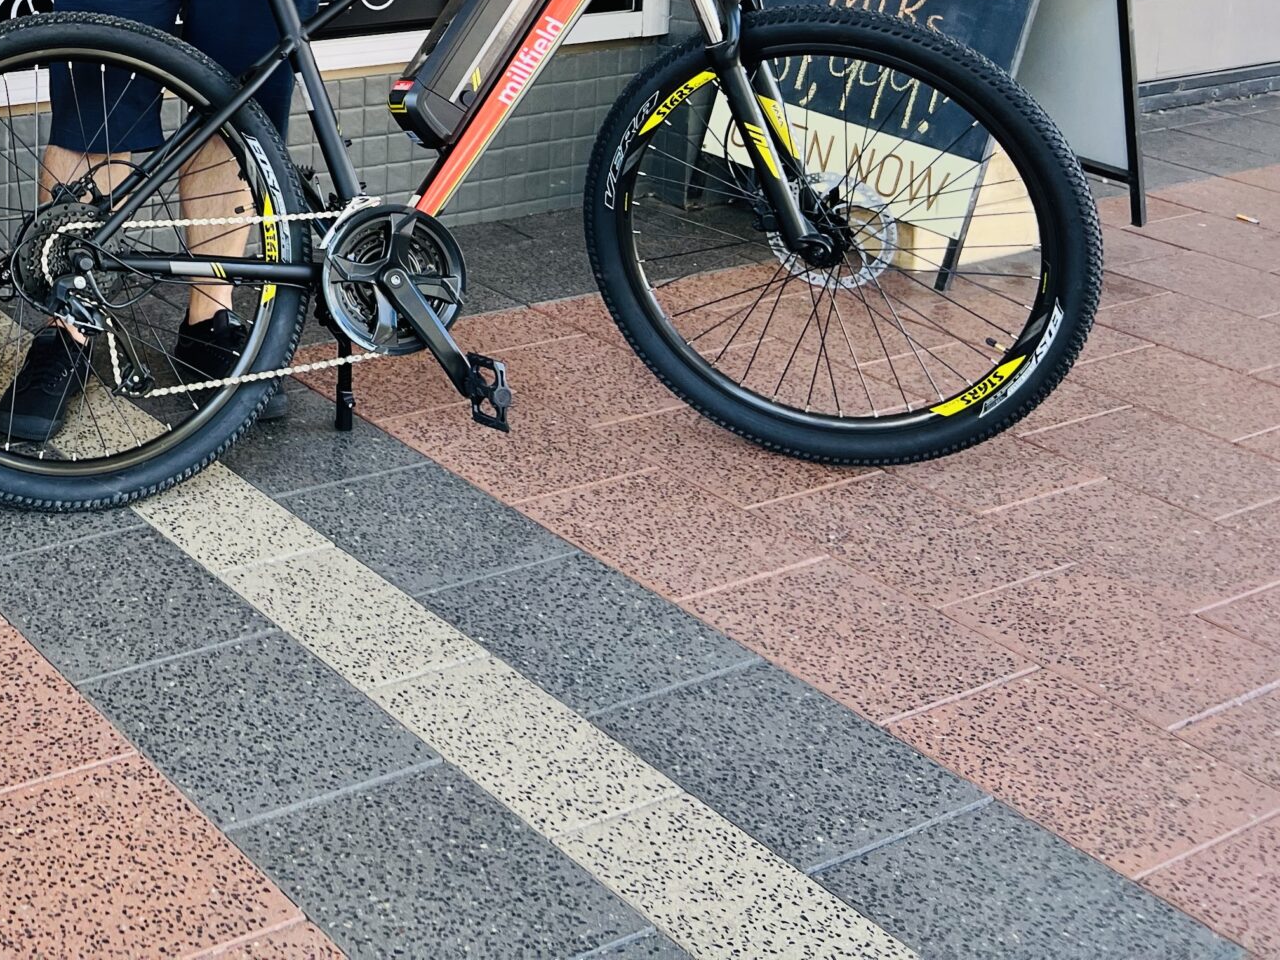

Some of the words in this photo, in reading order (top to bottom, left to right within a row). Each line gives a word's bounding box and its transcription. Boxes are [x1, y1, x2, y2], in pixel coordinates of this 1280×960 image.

[498, 15, 566, 106] millfield
[656, 84, 695, 118] STARS
[848, 142, 951, 212] NOW
[265, 224, 277, 263] STAR
[960, 371, 1005, 406] STARS
